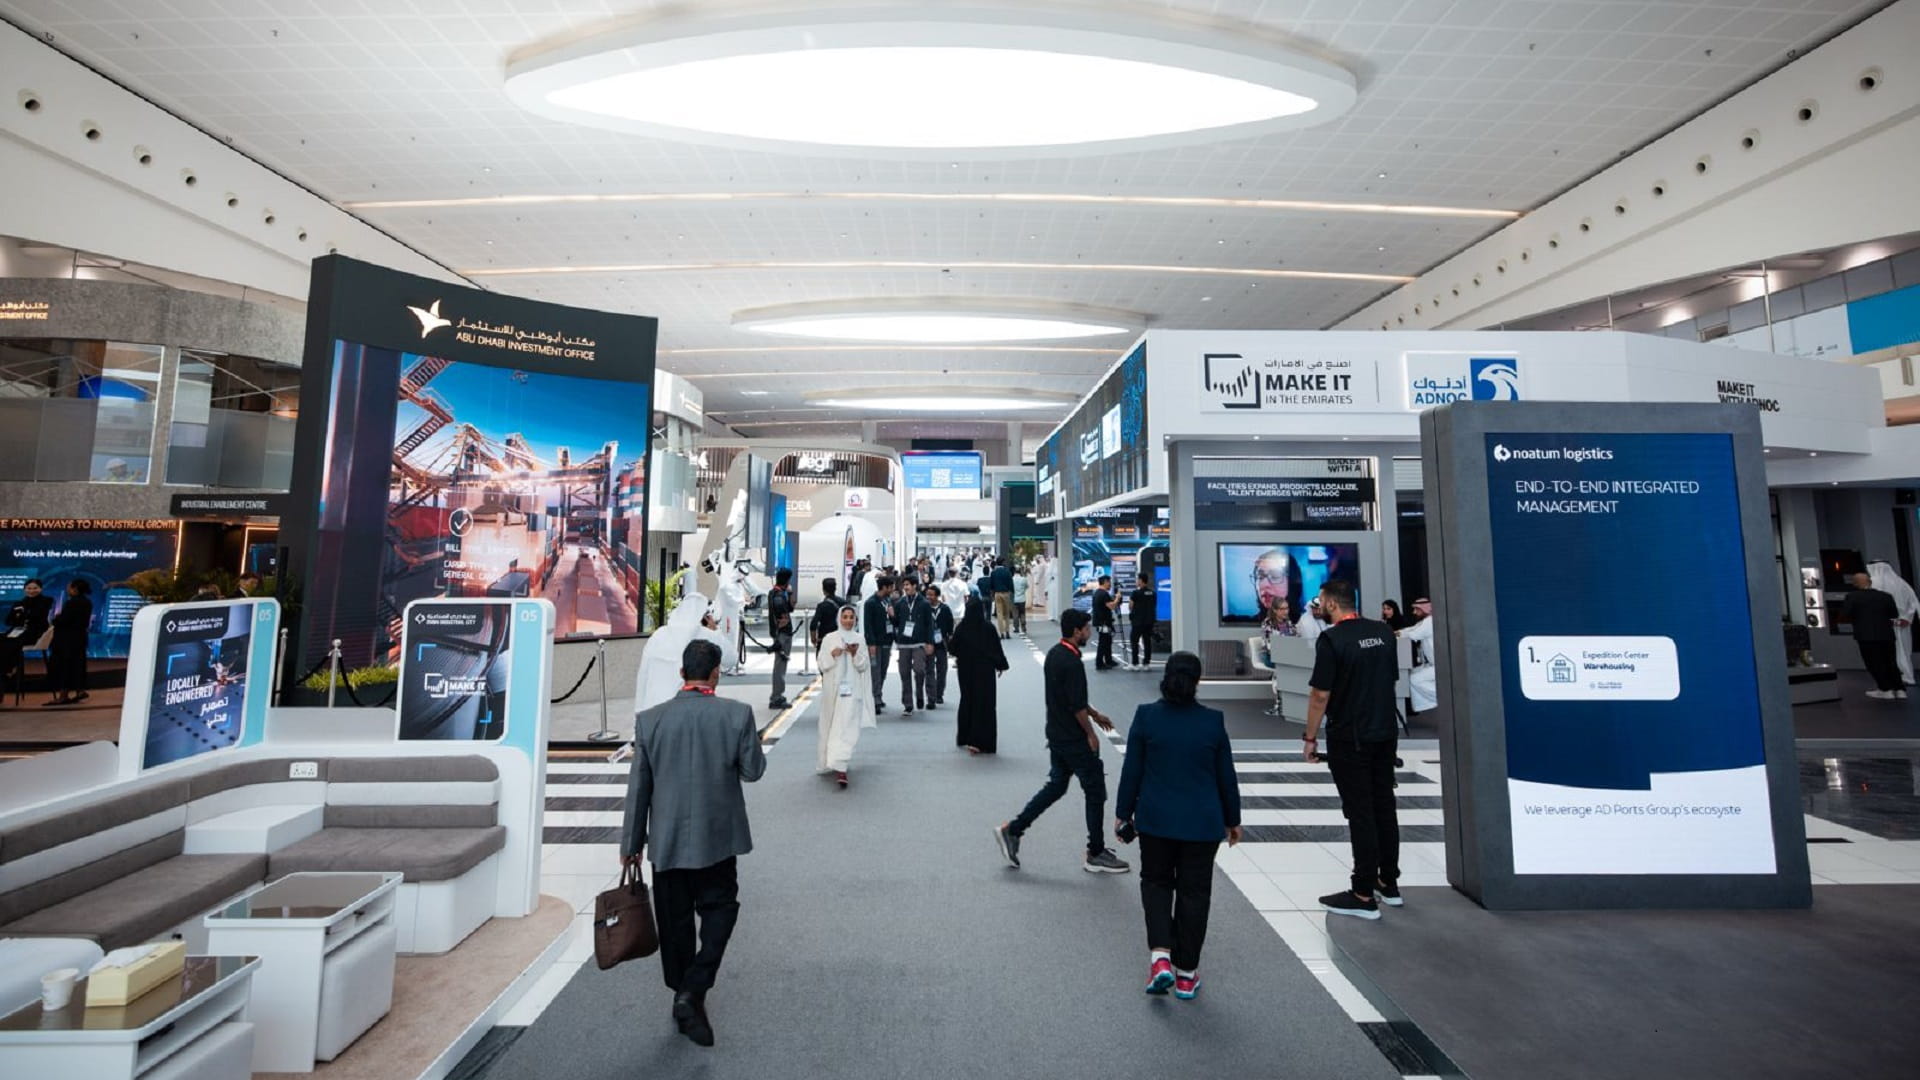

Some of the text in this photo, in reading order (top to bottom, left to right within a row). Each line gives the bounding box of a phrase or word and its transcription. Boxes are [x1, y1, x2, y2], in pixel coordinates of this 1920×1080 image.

[25, 312, 49, 320] OFFICE
[456, 317, 596, 347] مكتب أبوظبي للاستثمار
[456, 332, 596, 361] ABU DHABI INVESTMENT OFFICE
[1326, 360, 1351, 370] اصنع
[1265, 374, 1352, 391] MAKE IT
[1413, 376, 1467, 392] أدنوك
[1717, 380, 1755, 397] MAKE IT
[1265, 395, 1353, 405] IN THE EMIRATES
[1513, 447, 1614, 463] noatum logistics
[1515, 480, 1700, 495] END-TO-END INTEGRATED
[181, 500, 268, 510] INDUSTRIAL ENABLEMENT CENTRE
[1517, 500, 1619, 514] MANAGEMENT
[12, 520, 74, 529] PATHWAYS
[76, 520, 92, 529] TO
[93, 520, 145, 529] INDUSTRIAL
[146, 520, 177, 529] GROWTH
[13, 550, 45, 558] Unlock
[47, 550, 61, 558] the
[62, 550, 79, 558] Abu
[80, 550, 102, 558] Dhabi
[445, 543, 461, 553] BILL
[443, 571, 473, 579] GENERAL
[258, 609, 272, 622] 05
[520, 609, 538, 623] 05
[1358, 637, 1385, 649] MEDIA
[1527, 645, 1541, 664] 1.
[1582, 651, 1649, 661] Expedition Center
[1583, 662, 1635, 673] Warehousing
[167, 674, 201, 692] LOCALLY
[449, 681, 487, 691] MAKE IT
[165, 685, 214, 706] ENGINEERED
[200, 696, 229, 717] تصميم
[206, 713, 228, 729] محلي
[1524, 804, 1742, 819] We leverage AD Ports Group's ecosyste
